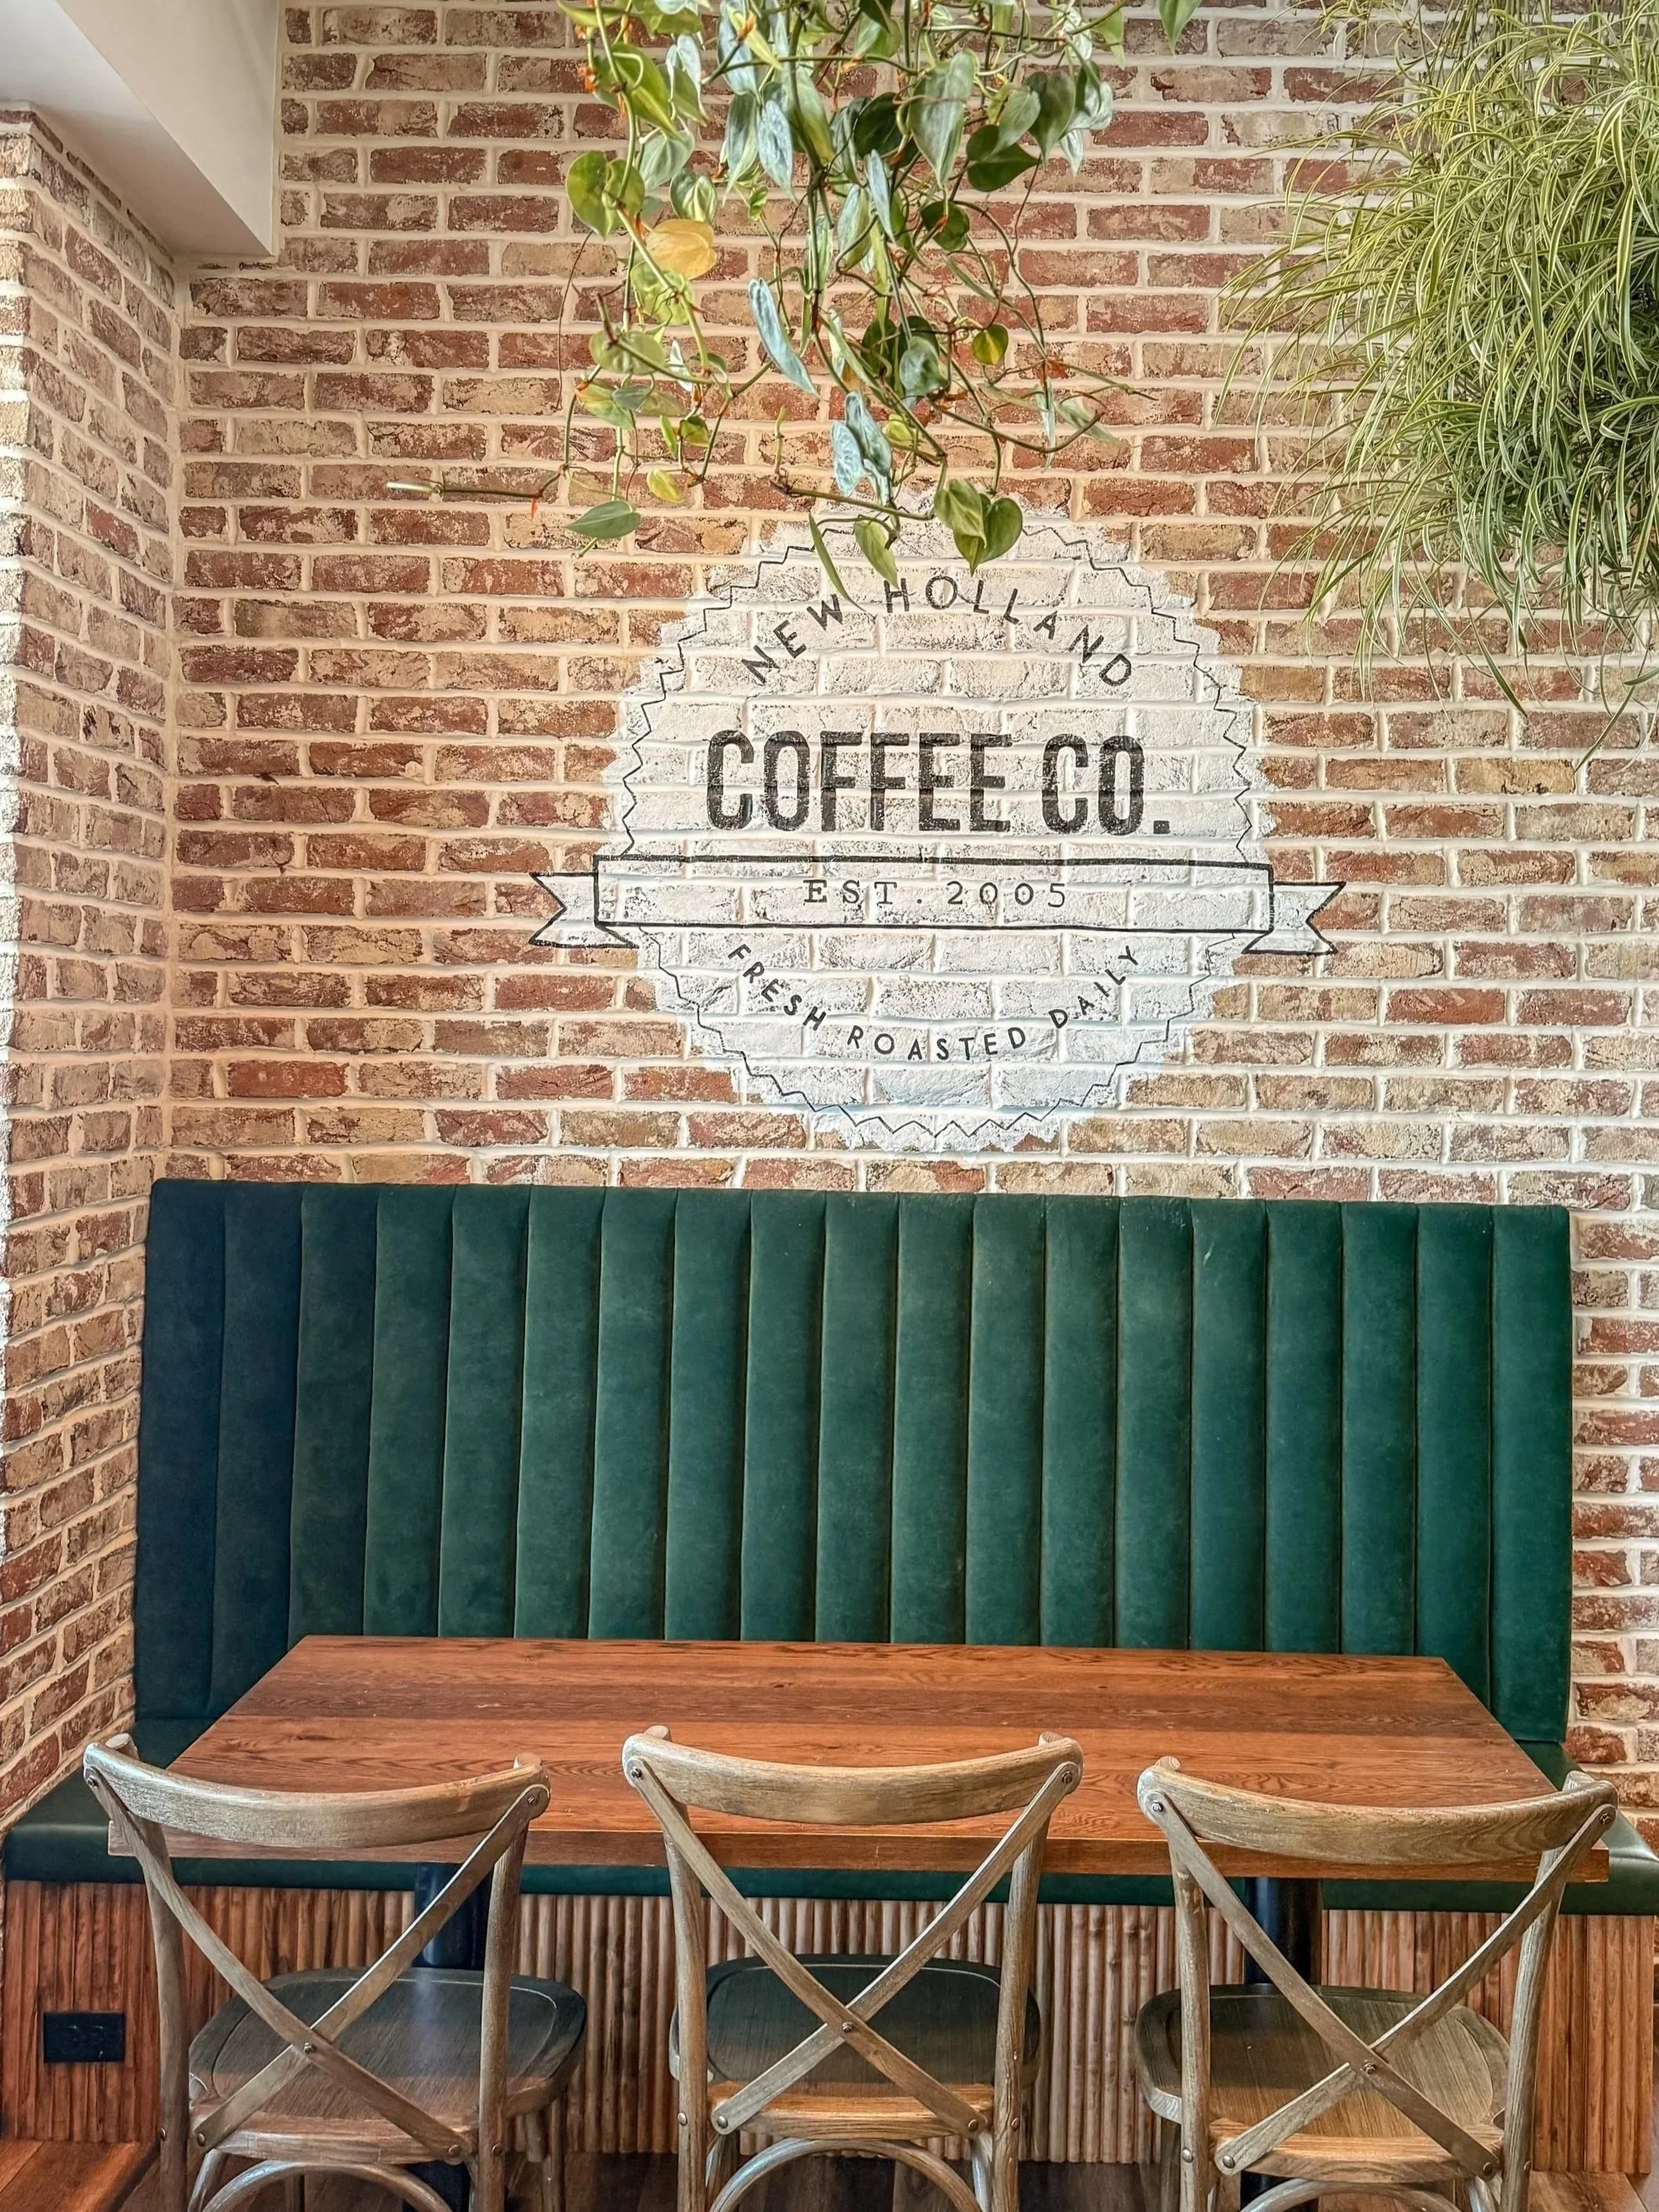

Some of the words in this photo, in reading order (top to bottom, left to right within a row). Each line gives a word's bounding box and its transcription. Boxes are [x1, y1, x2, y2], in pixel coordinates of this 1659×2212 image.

[742, 593, 843, 684] NEW
[884, 575, 1133, 687] HOLLAND
[706, 729, 1013, 832] COFFEE
[1042, 733, 1171, 835] CO.
[946, 880, 1067, 908] 2005
[728, 943, 828, 1031] FRESH
[847, 1024, 1026, 1061] ROASTED
[1048, 945, 1139, 1029] DAILY
